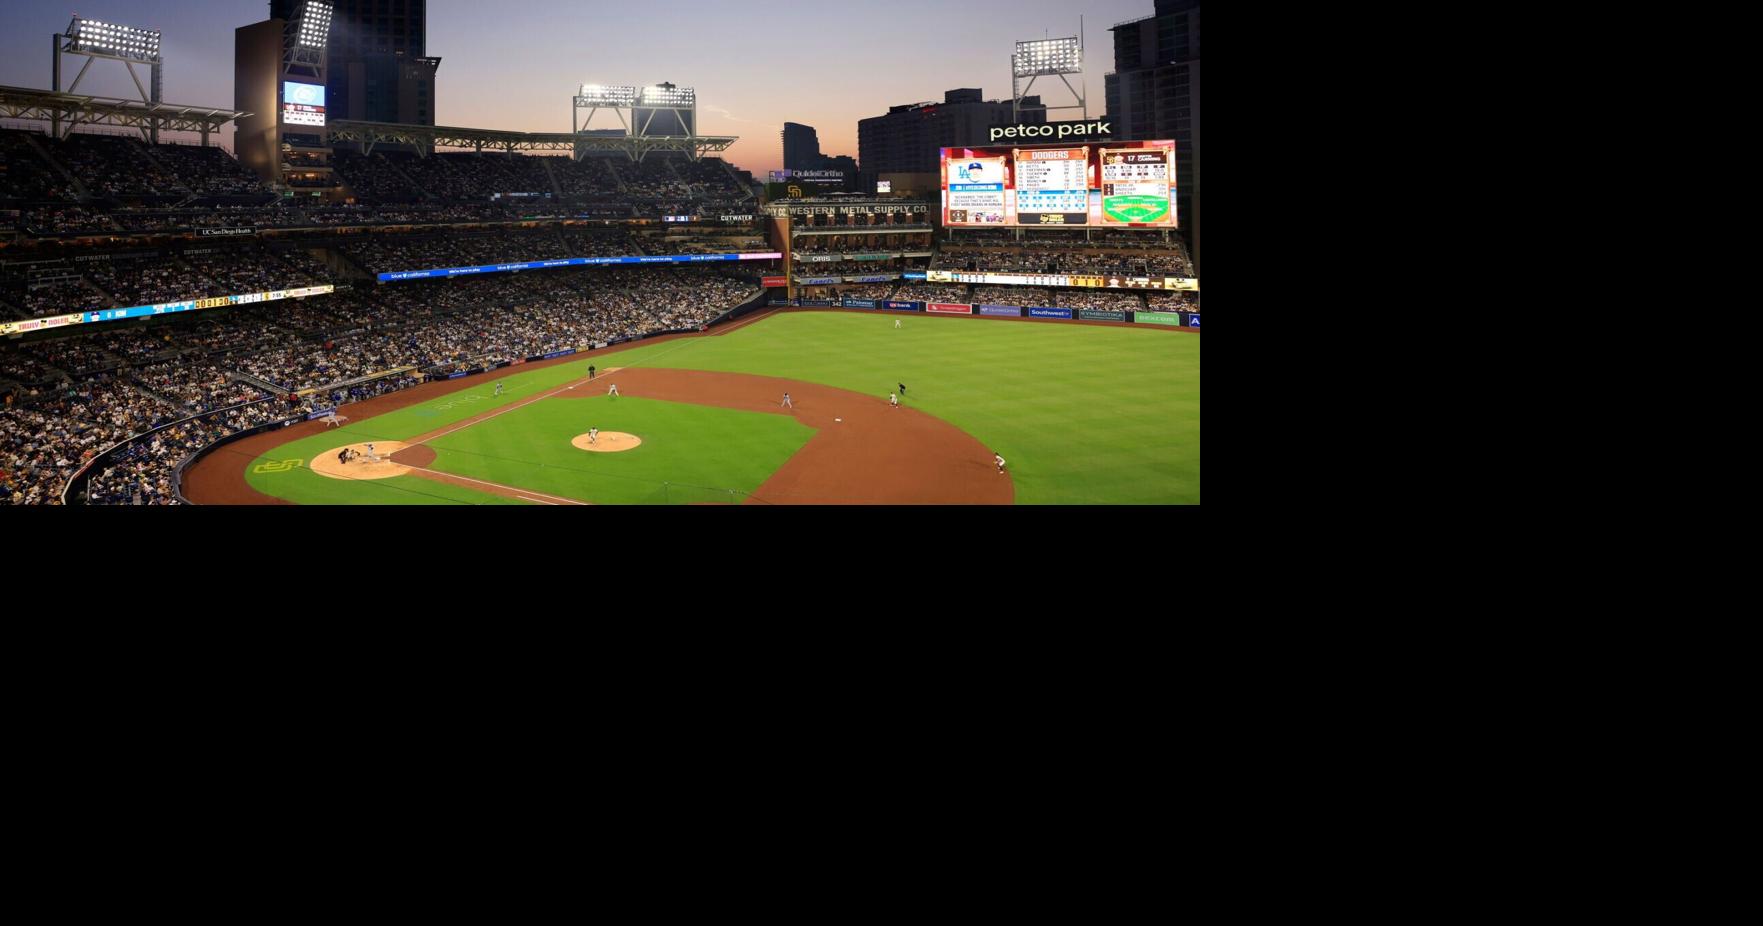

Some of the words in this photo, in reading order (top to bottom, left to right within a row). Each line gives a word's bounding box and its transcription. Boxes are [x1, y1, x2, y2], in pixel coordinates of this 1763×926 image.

[990, 124, 1054, 142] petco
[1058, 122, 1111, 138] park
[1032, 151, 1068, 160] DODGERS
[792, 170, 844, 178] QuidelOrtho
[958, 166, 970, 178] LA
[874, 206, 910, 214] SUPPLY
